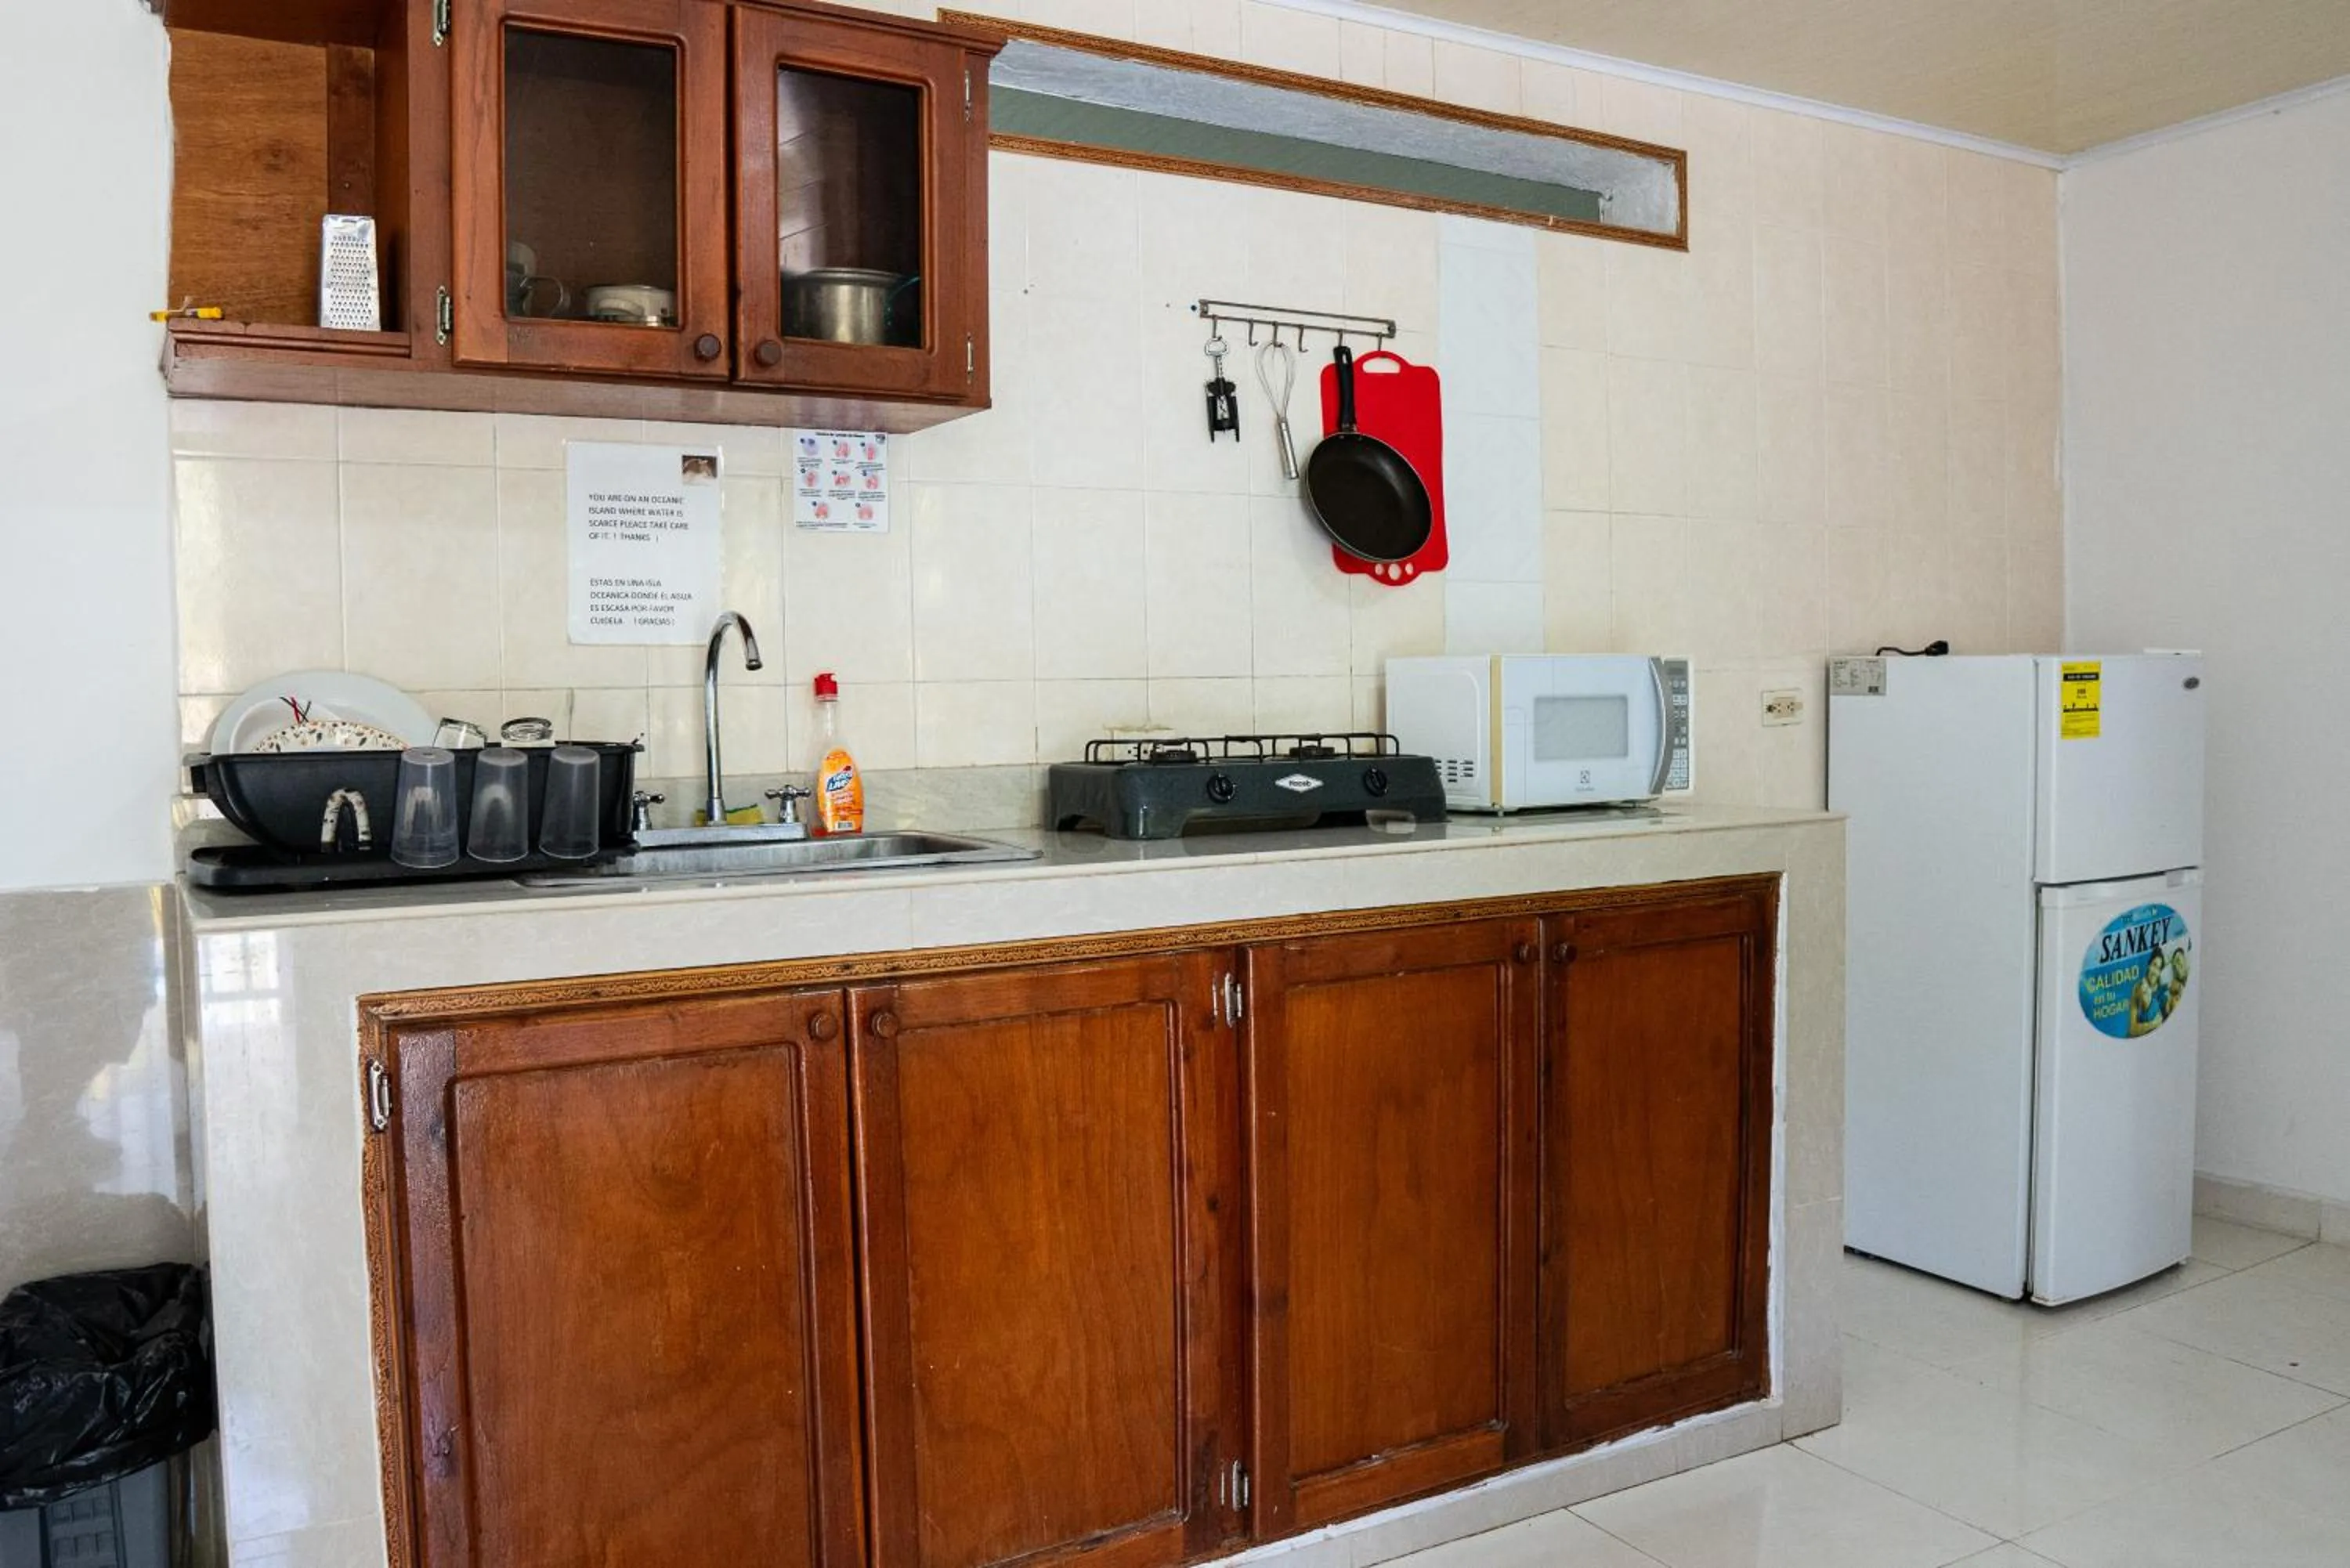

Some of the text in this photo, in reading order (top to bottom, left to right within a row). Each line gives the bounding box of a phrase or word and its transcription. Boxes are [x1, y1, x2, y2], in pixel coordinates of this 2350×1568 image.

[669, 522, 689, 530] CARE
[2100, 917, 2172, 963] SANKEY
[2085, 964, 2139, 993] CALIDAD
